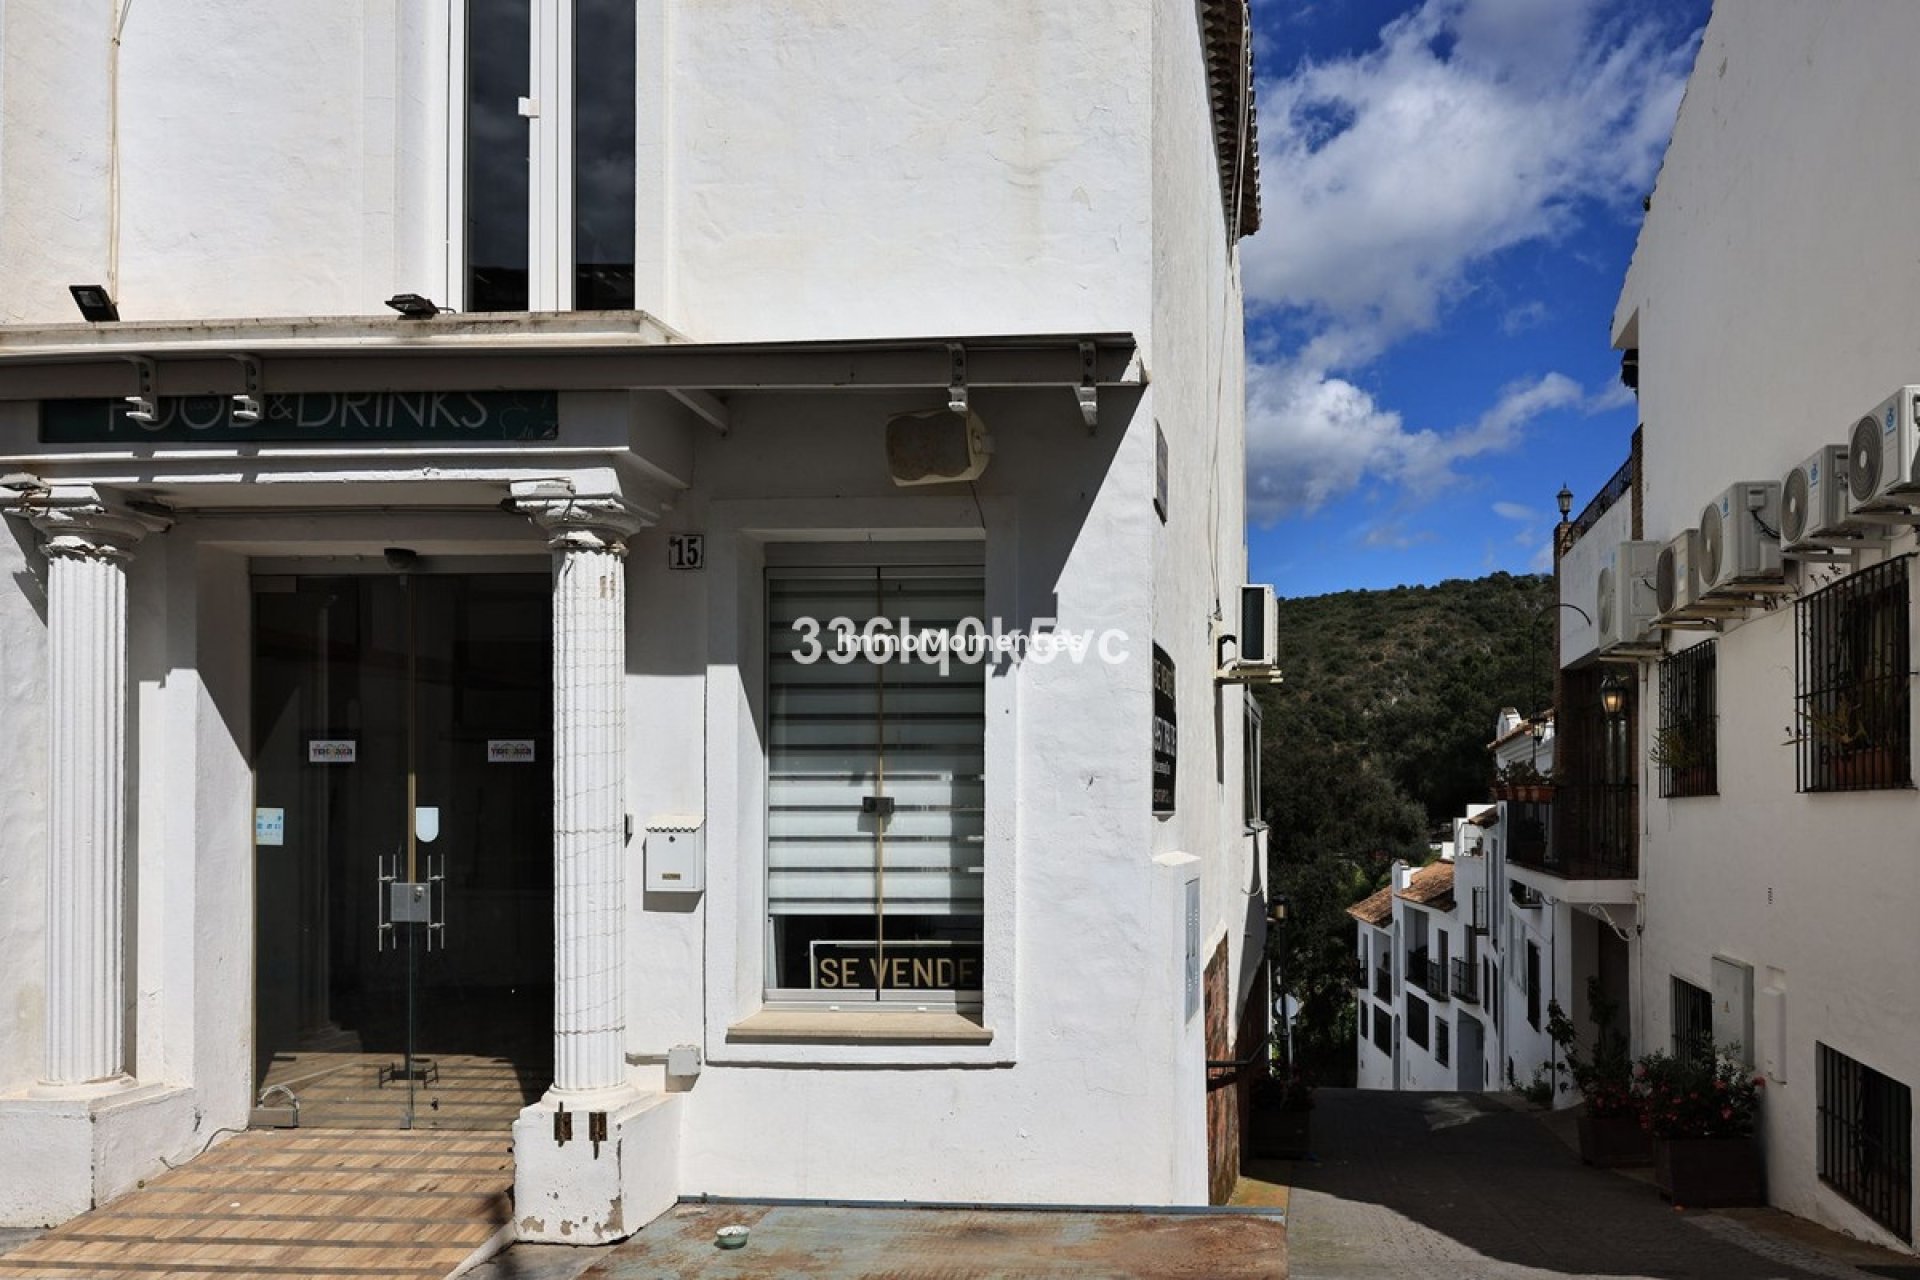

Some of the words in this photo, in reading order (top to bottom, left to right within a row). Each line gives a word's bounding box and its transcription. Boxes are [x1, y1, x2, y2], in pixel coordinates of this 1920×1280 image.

[670, 537, 698, 565] 15
[820, 958, 860, 988] SE
[869, 958, 977, 988] VENDE
